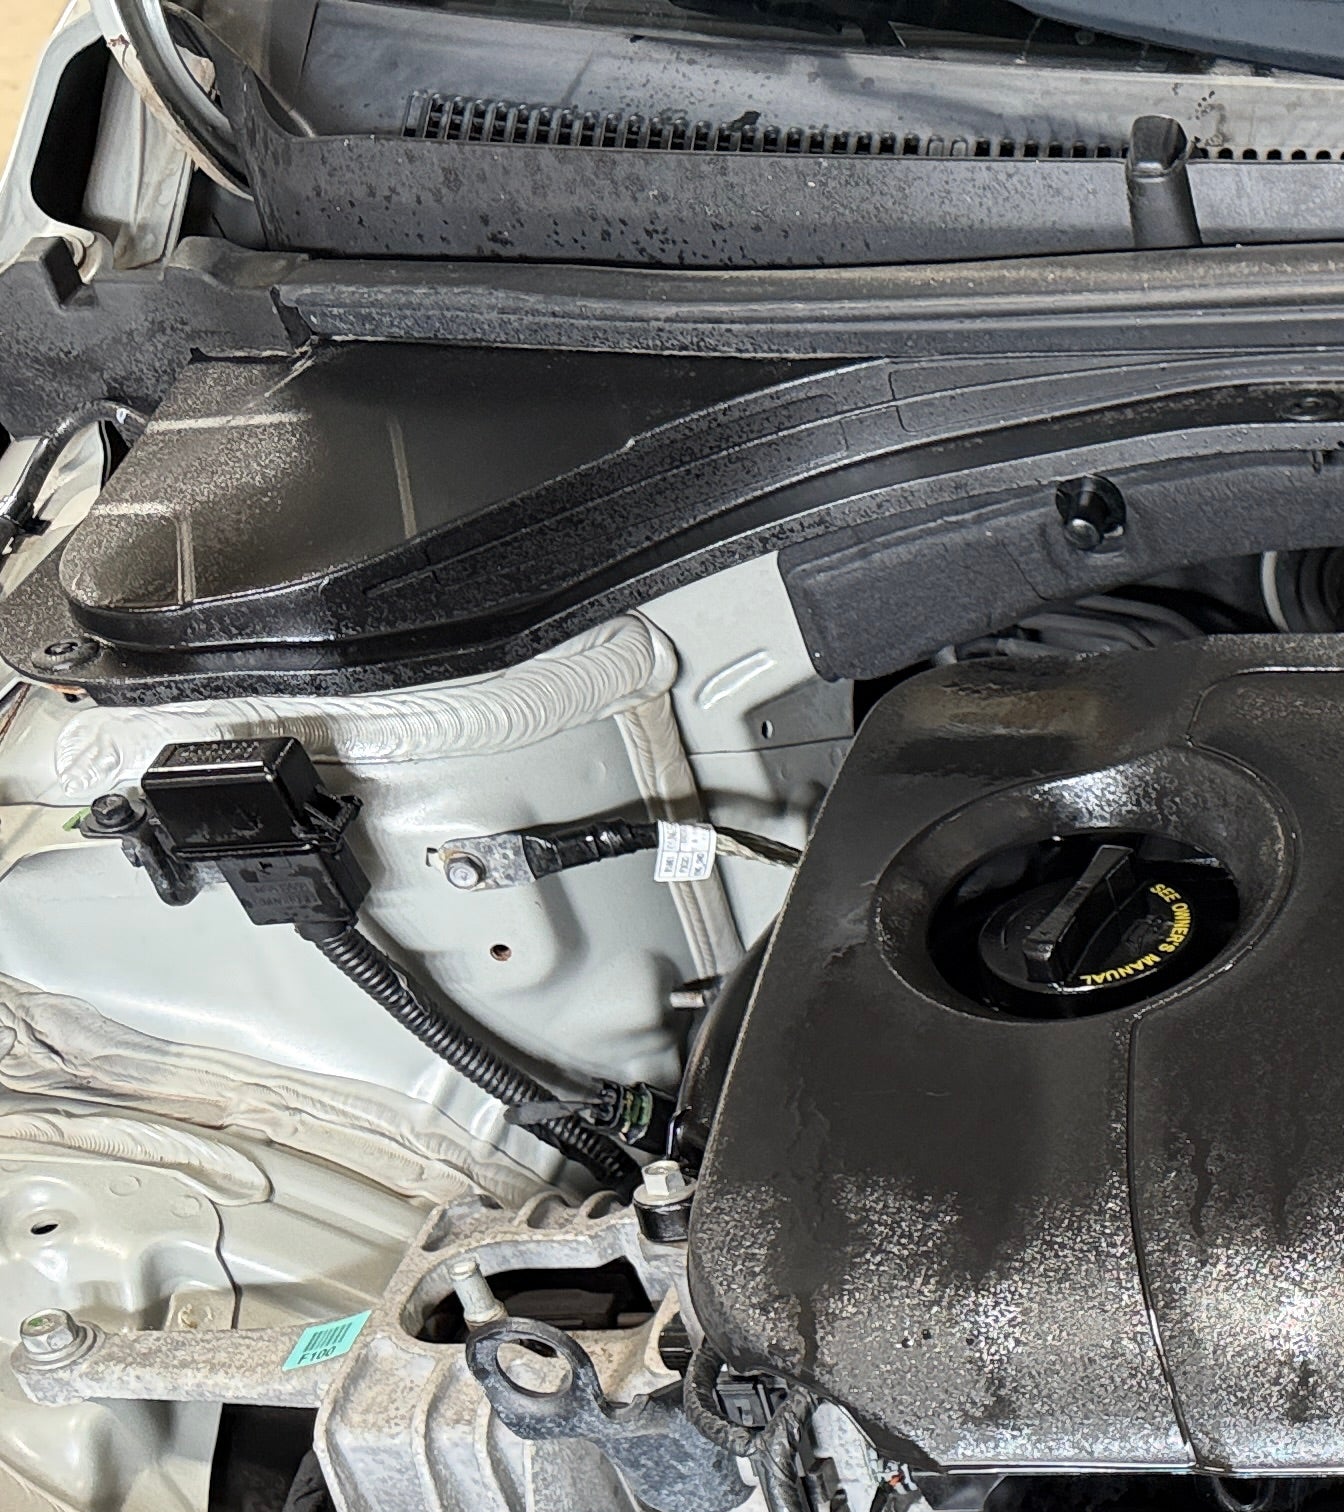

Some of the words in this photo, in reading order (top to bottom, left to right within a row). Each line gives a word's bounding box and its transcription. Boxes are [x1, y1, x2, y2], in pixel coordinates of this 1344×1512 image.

[1150, 884, 1181, 902] SEE
[1159, 902, 1191, 953] OWNER'S
[1080, 953, 1161, 985] MANUAL
[297, 1346, 337, 1365] F100
